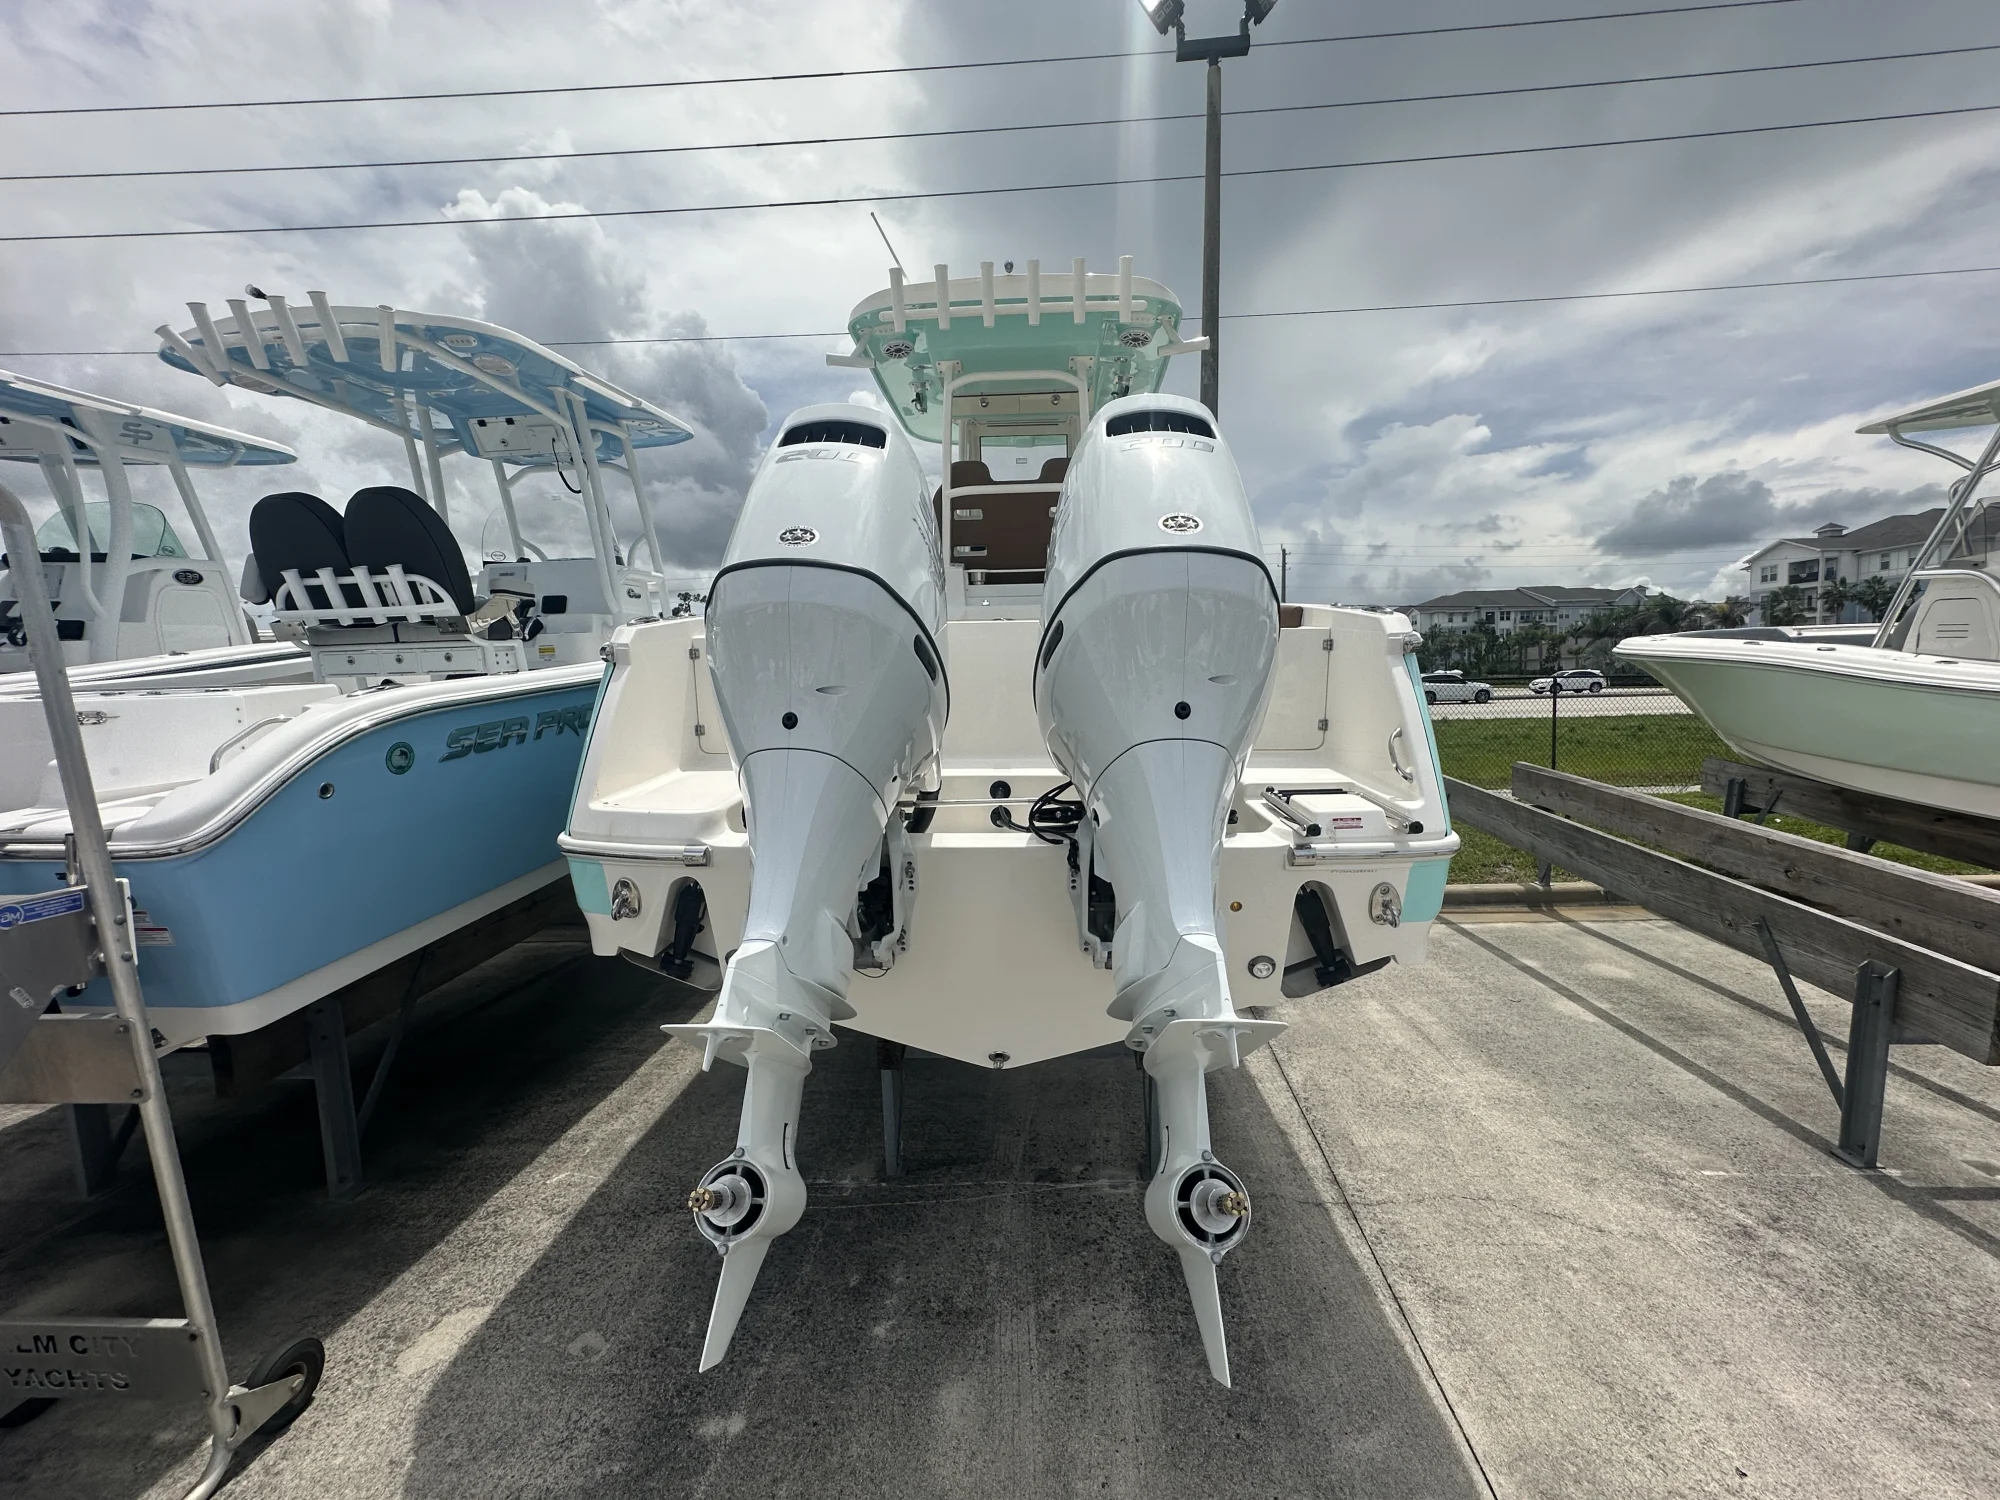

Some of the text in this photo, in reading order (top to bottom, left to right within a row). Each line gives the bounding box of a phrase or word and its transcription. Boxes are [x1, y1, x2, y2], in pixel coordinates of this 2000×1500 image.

[178, 572, 200, 580] 239
[438, 715, 529, 763] SEA
[3, 1368, 130, 1390] YACHTS
